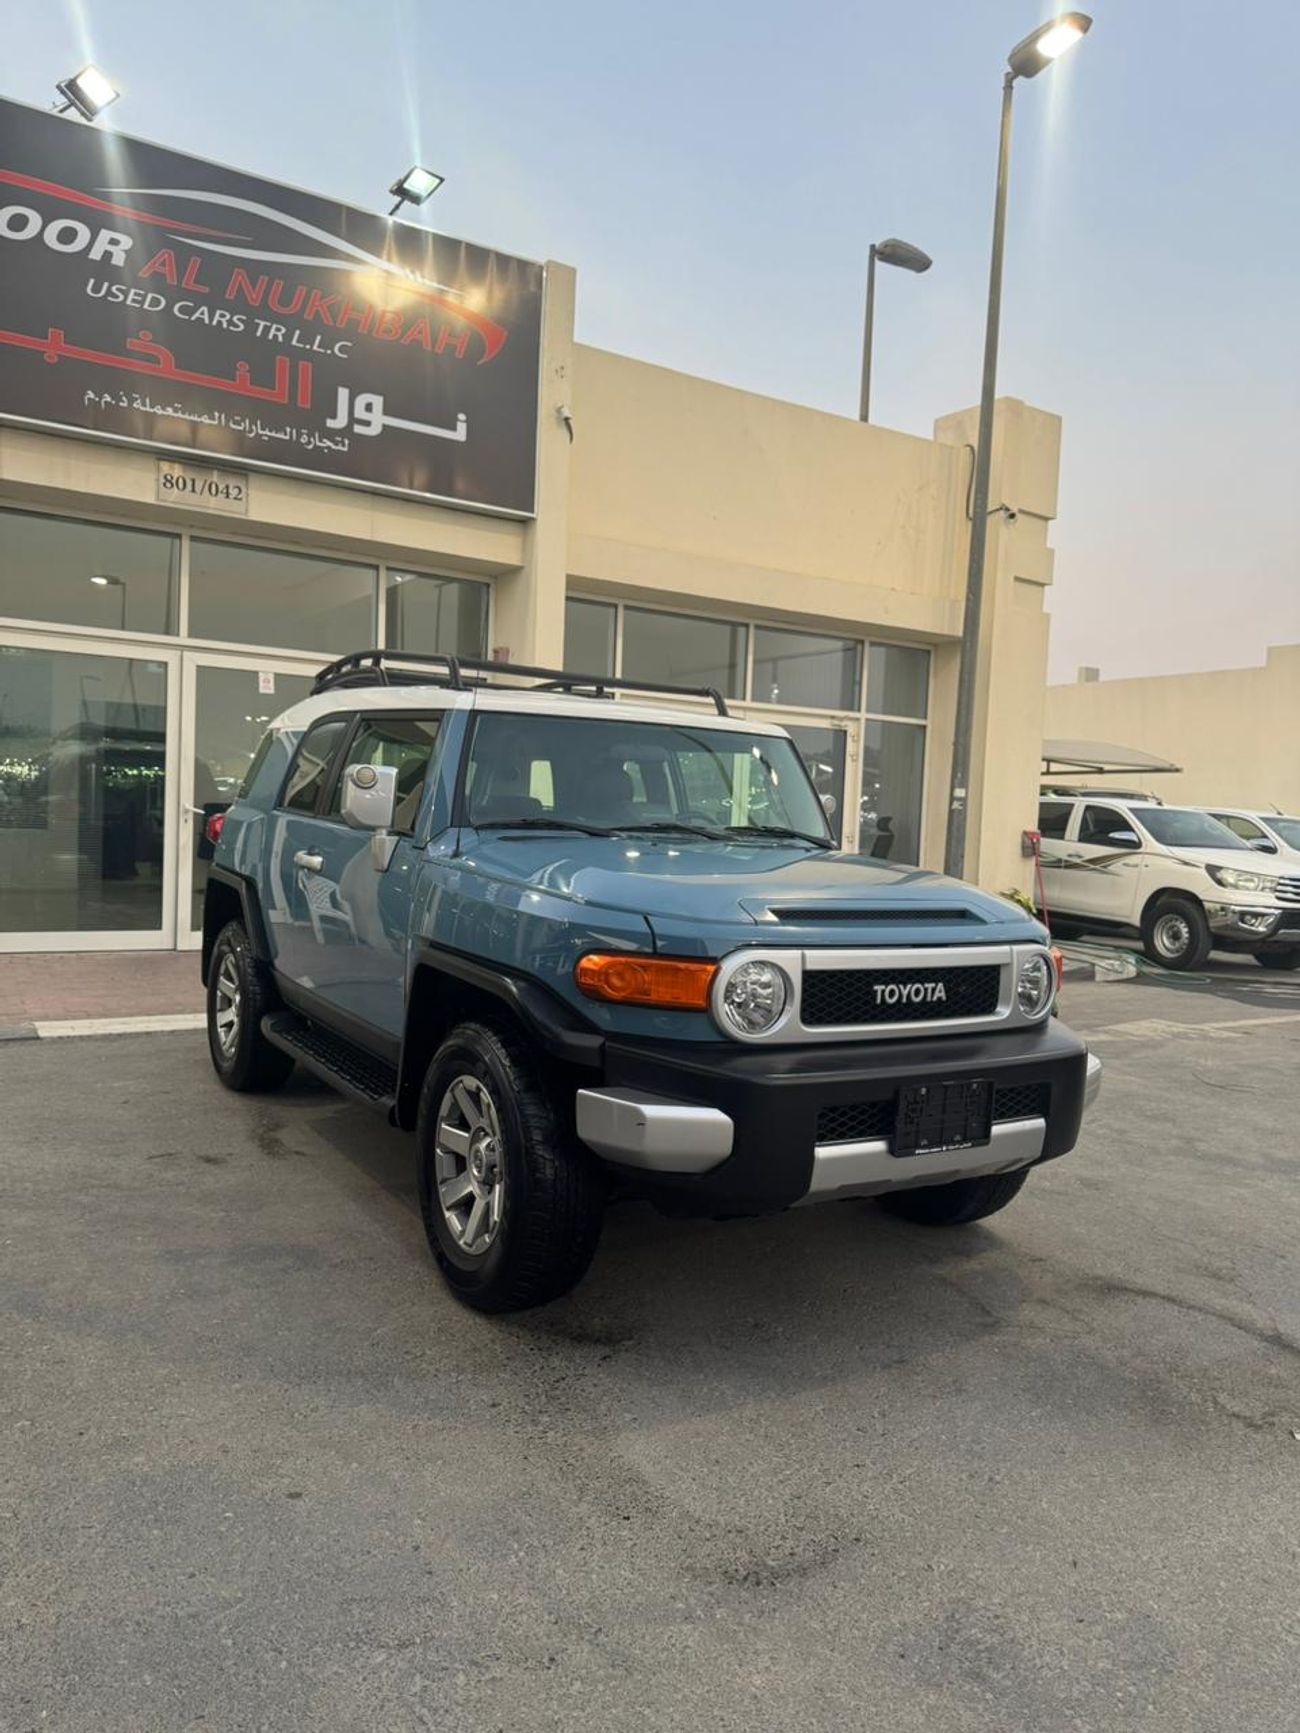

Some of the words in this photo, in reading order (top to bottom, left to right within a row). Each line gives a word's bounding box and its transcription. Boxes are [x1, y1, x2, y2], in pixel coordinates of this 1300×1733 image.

[0, 205, 133, 267] OOR
[138, 249, 209, 293] AL
[225, 267, 471, 358] NUKHBAH
[86, 278, 166, 312] USED
[173, 301, 247, 331] CARS
[253, 319, 286, 342] TR
[291, 329, 353, 358] L.L.C
[0, 328, 312, 409] النخب
[132, 393, 225, 427] المستعملة
[326, 386, 467, 442] نور
[229, 416, 297, 440] السيارات
[300, 428, 349, 453] لتجارة
[162, 473, 243, 501] 801/042
[873, 982, 947, 1004] TOYOTA
